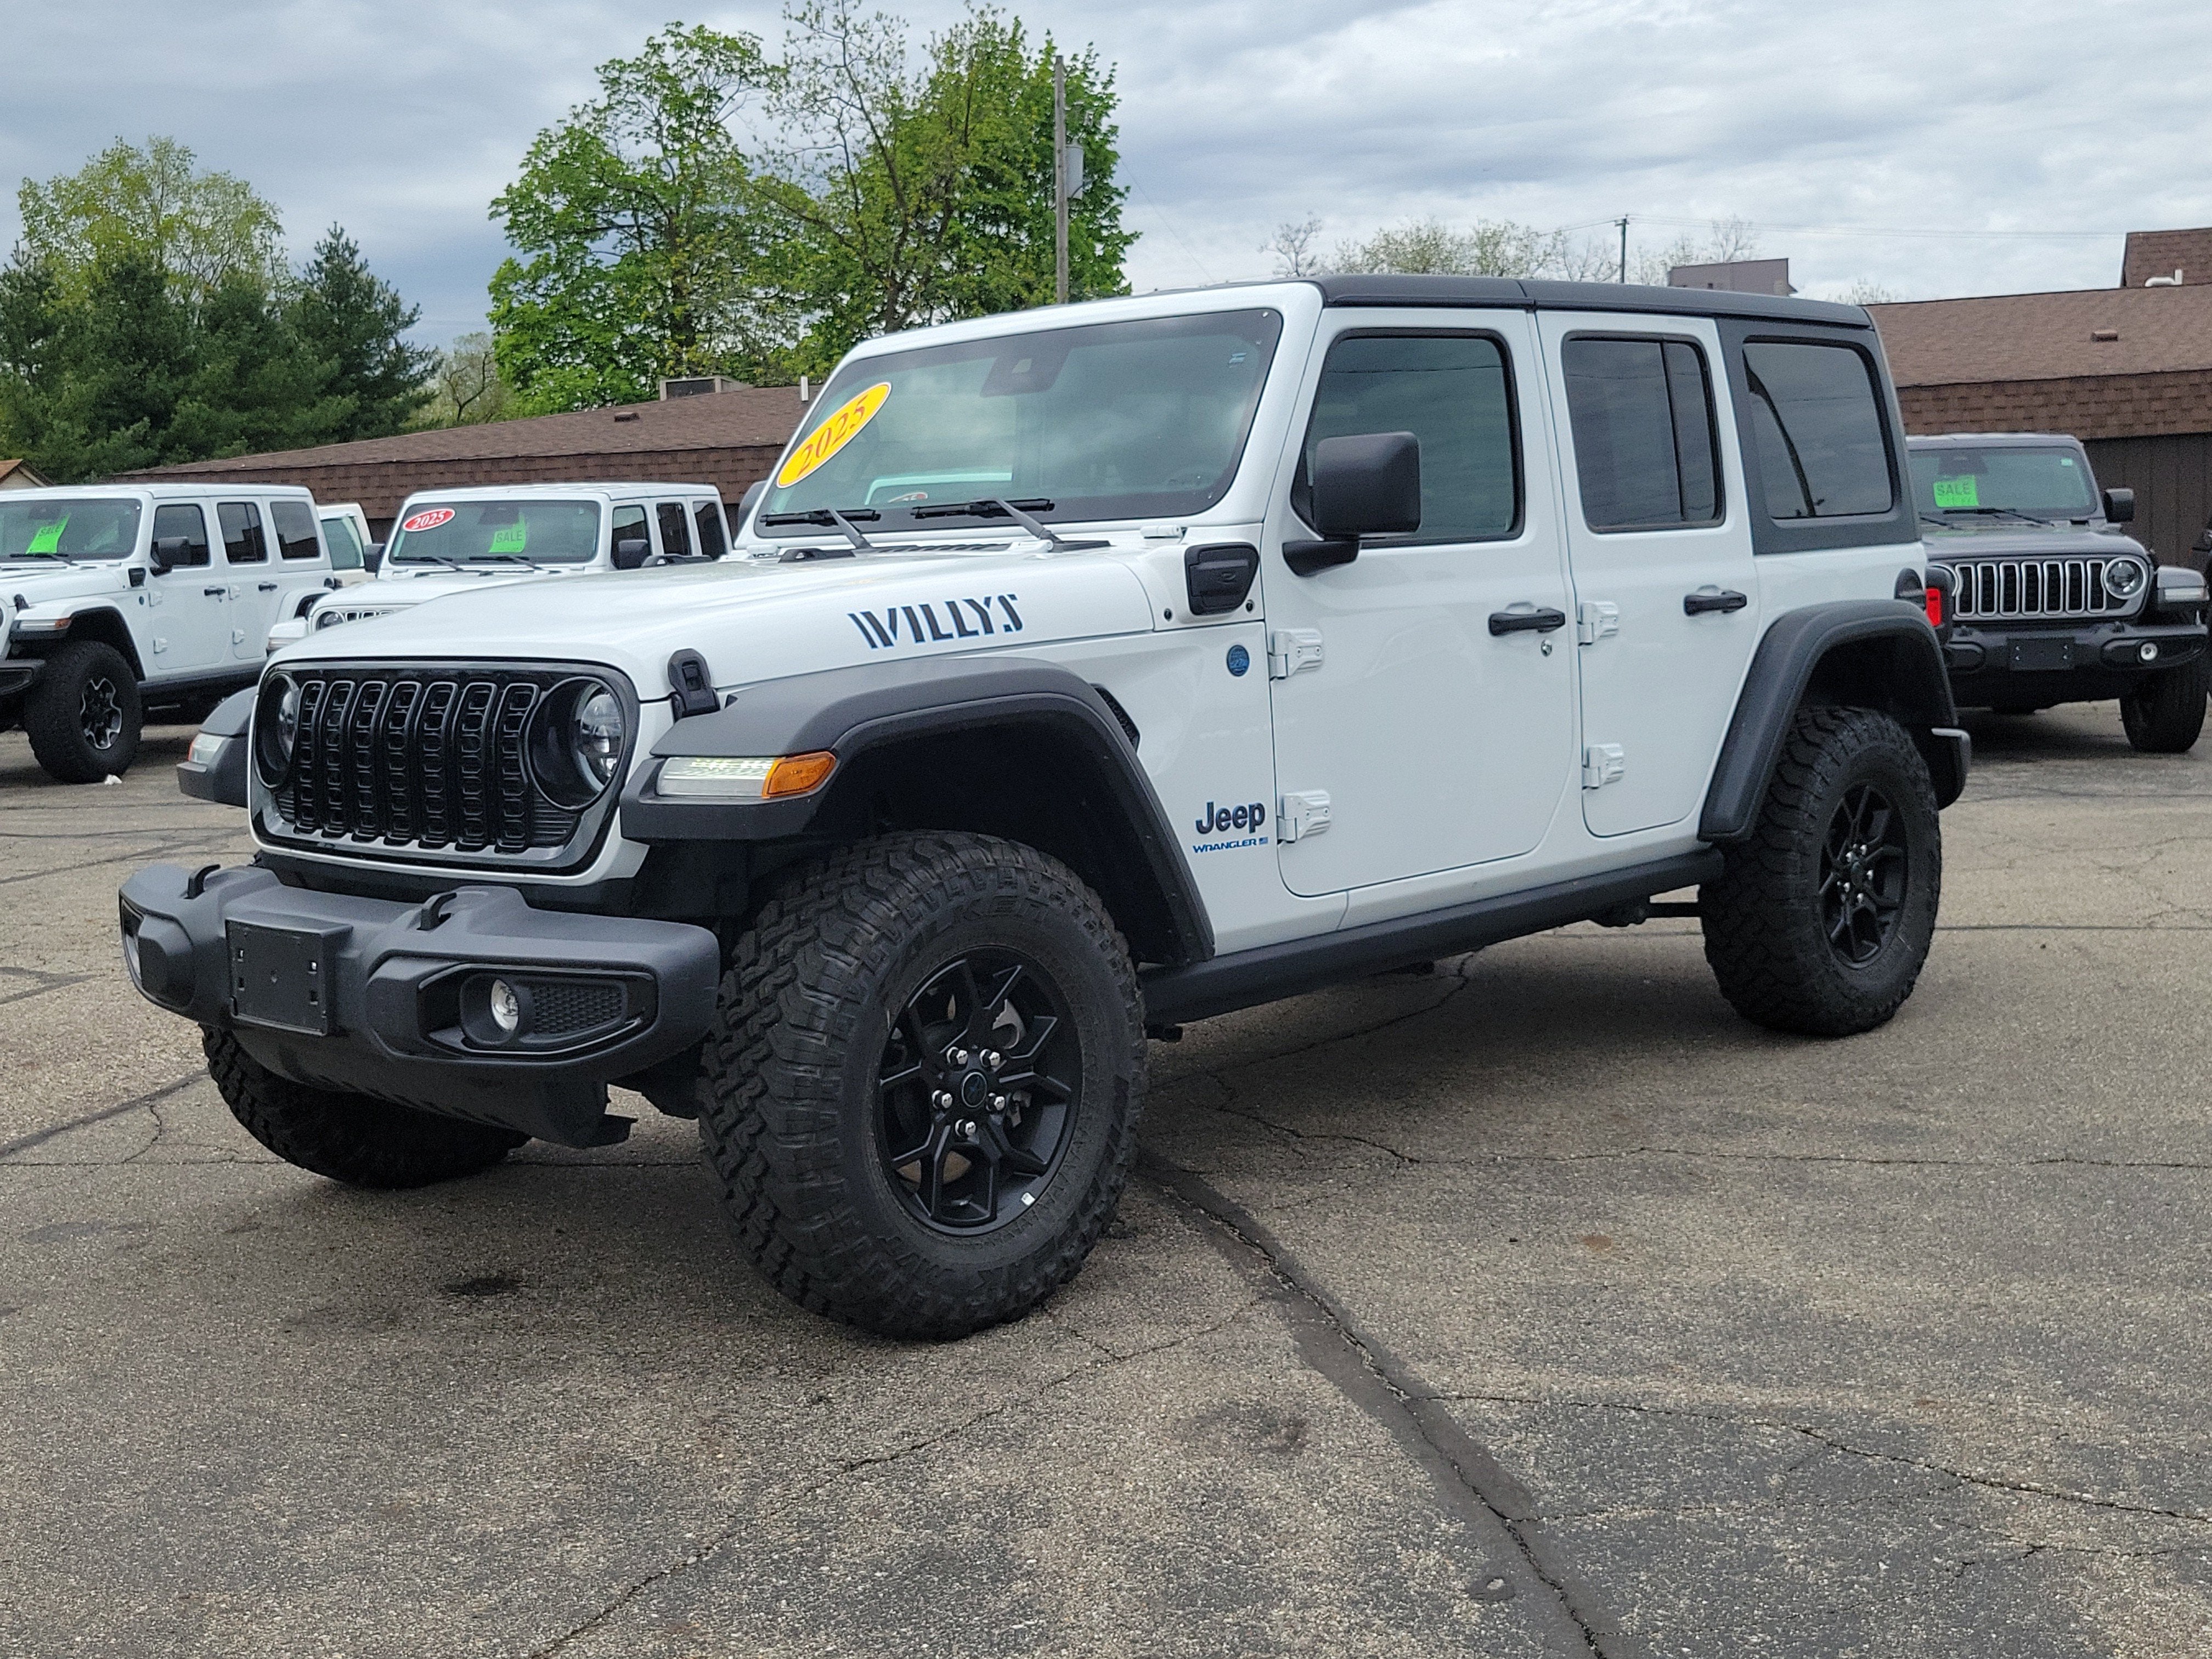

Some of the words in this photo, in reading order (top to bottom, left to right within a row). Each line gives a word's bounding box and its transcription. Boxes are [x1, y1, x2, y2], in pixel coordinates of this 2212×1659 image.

[797, 396, 868, 477] 2025
[413, 511, 445, 529] 2025
[496, 530, 522, 543] SALE
[847, 594, 1023, 648] WILLYS
[1195, 801, 1265, 834] Jeep
[1193, 838, 1257, 853] WRANGLER
